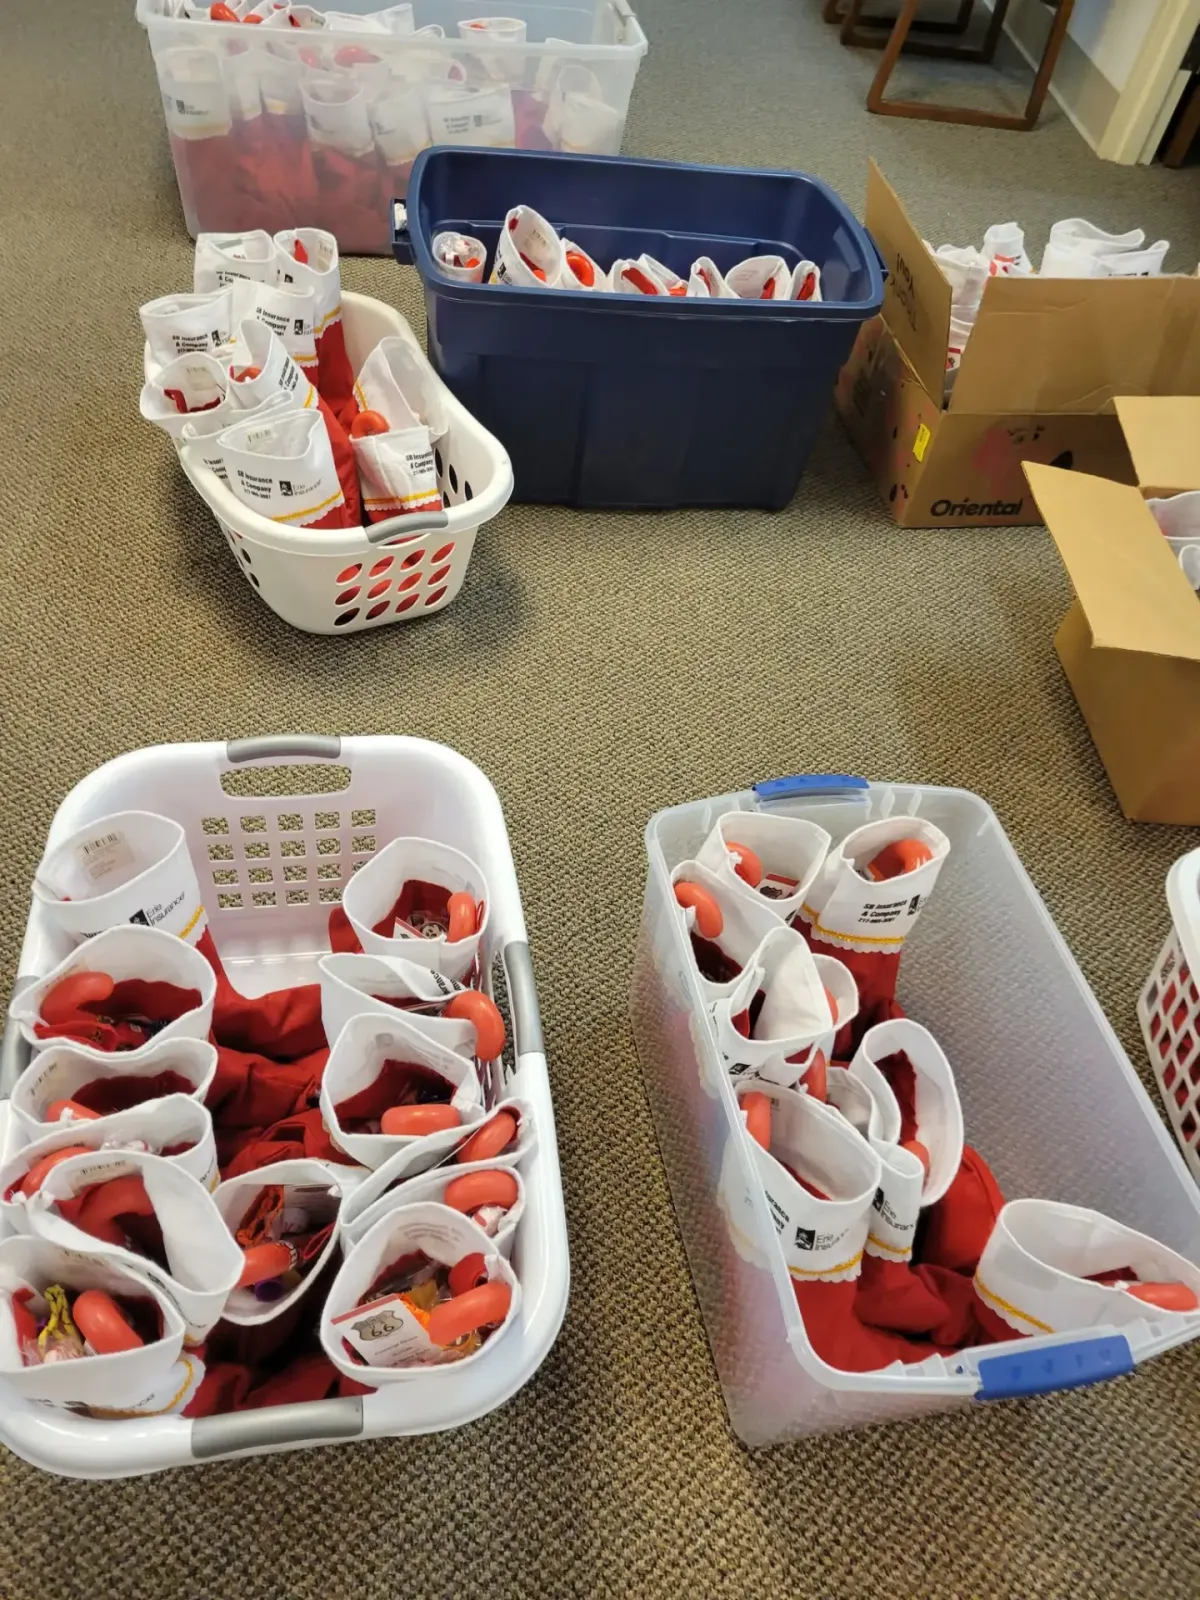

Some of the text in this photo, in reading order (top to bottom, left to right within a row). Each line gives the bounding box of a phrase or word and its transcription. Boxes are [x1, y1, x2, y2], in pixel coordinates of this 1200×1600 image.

[245, 472, 273, 484] Insurance
[246, 480, 272, 494] Company
[930, 497, 1024, 517] Oriental
[146, 903, 163, 918] Erie
[150, 891, 186, 926] Insurance
[875, 899, 908, 910] Insurance
[869, 909, 902, 918] Company
[371, 1324, 395, 1337] 66
